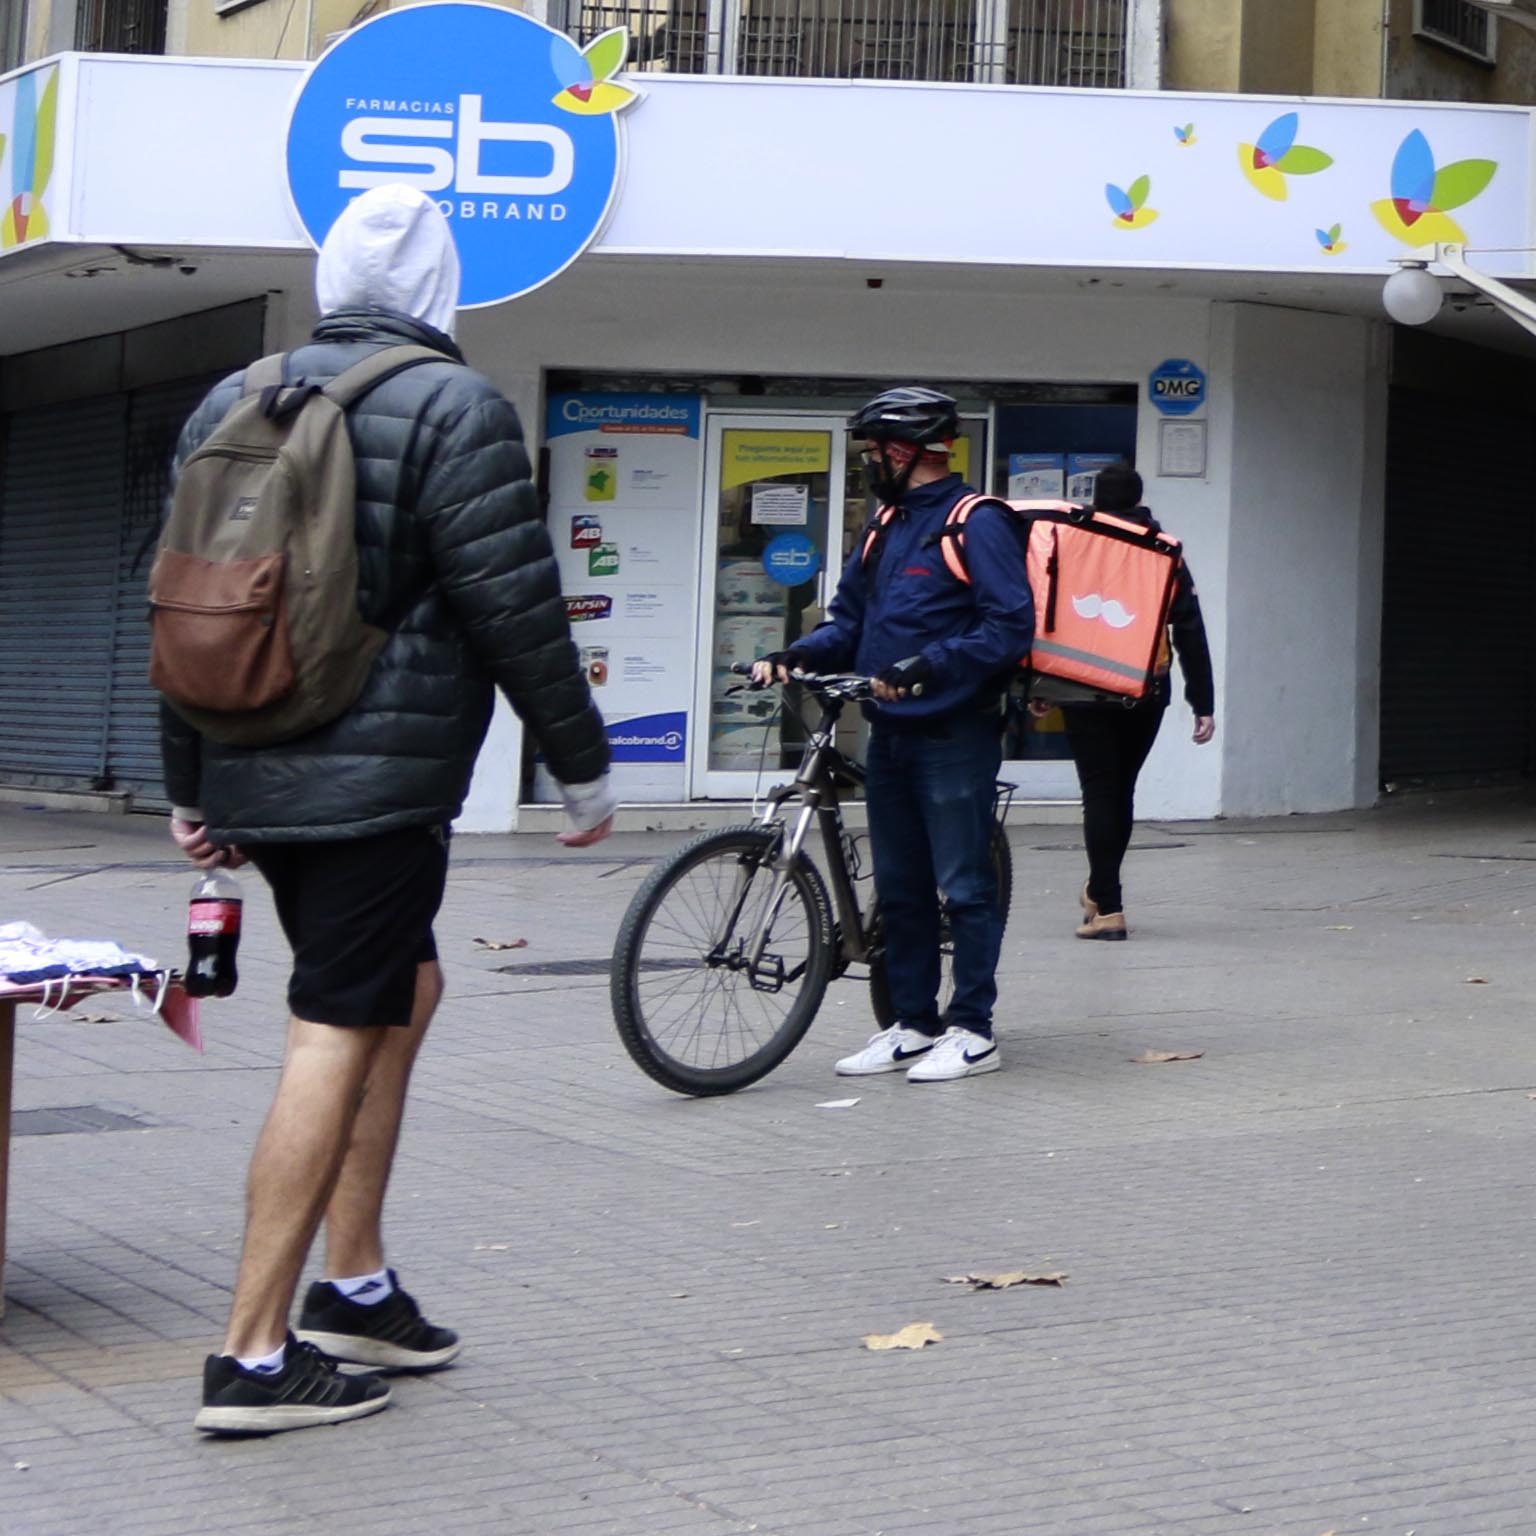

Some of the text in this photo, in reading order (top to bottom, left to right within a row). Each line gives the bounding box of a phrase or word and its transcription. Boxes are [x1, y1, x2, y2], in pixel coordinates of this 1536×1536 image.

[346, 98, 454, 114] FARMACIAS
[339, 94, 574, 195] sb
[349, 197, 567, 221] OBRAND
[1153, 379, 1200, 396] DMG
[771, 548, 810, 566] sb
[566, 600, 608, 611] TAPSIN
